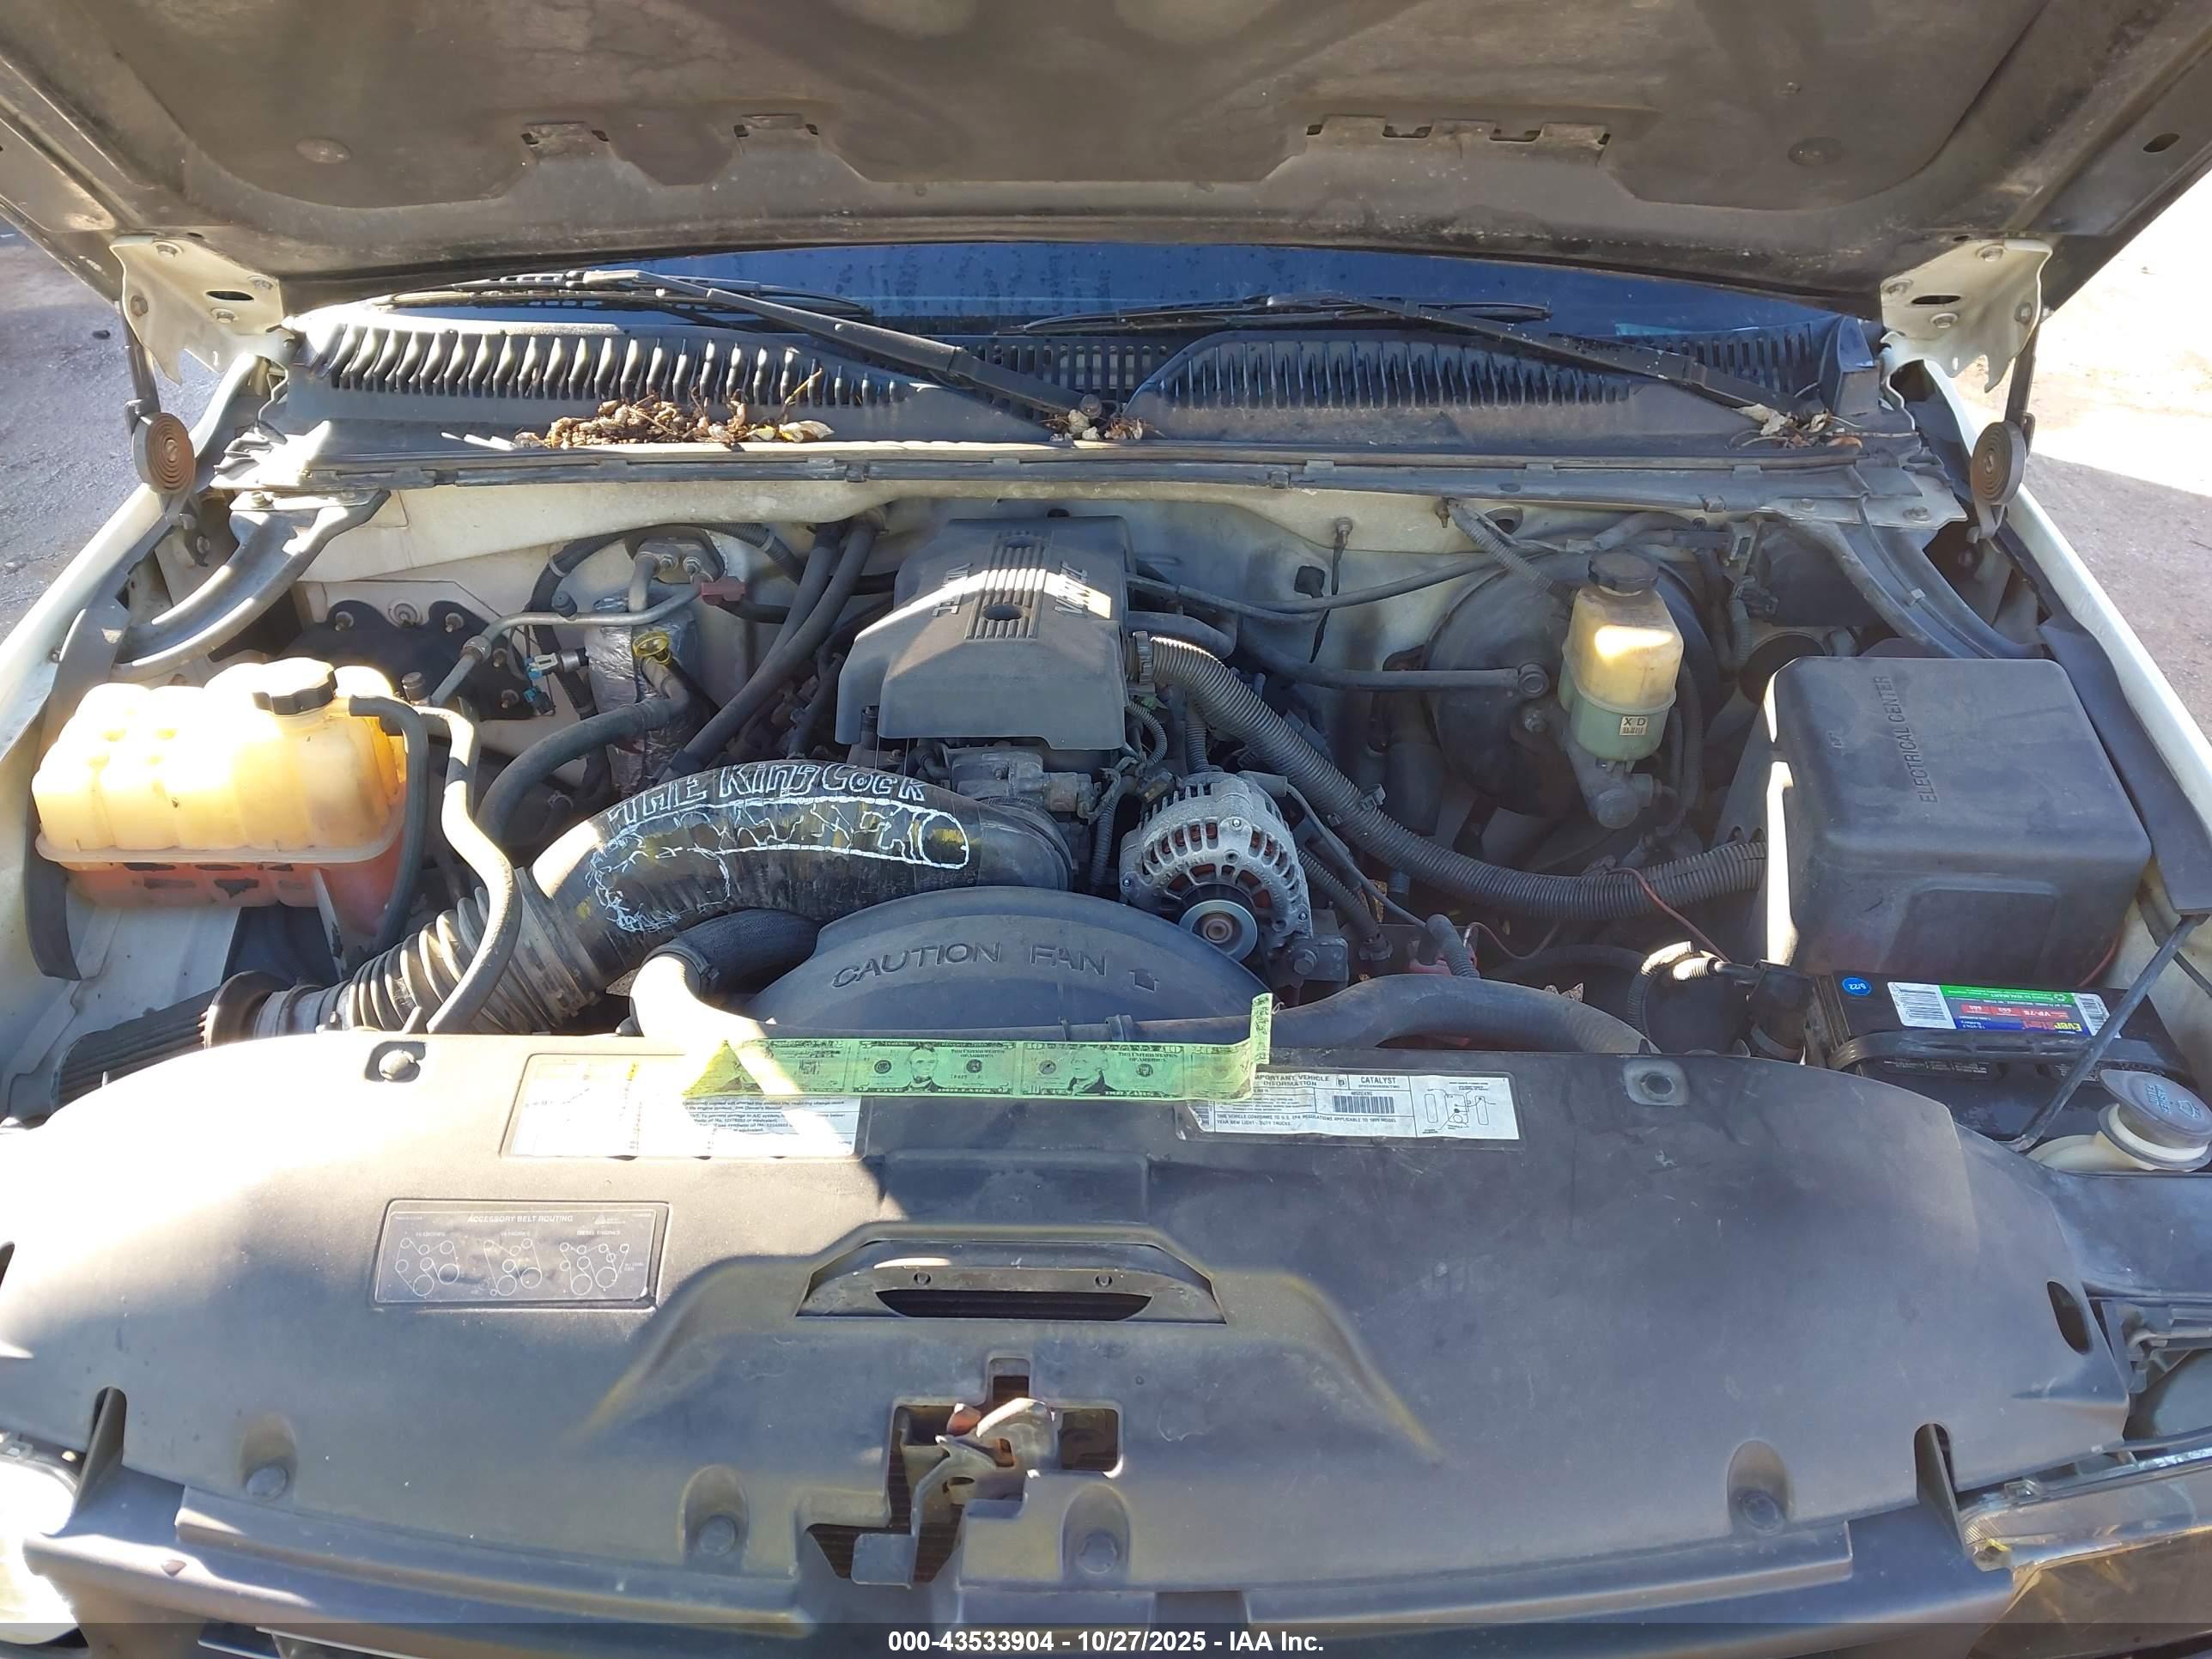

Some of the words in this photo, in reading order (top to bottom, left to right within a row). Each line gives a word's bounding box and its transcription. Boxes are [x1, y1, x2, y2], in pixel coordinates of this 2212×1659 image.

[1873, 675, 1906, 723] CENTER
[1894, 726, 1938, 804] ELECTRICAL
[606, 778, 708, 823] THE
[831, 941, 1001, 988] CAUTION
[1030, 944, 1108, 976] FAN
[2022, 1019, 2082, 1032] EverStart
